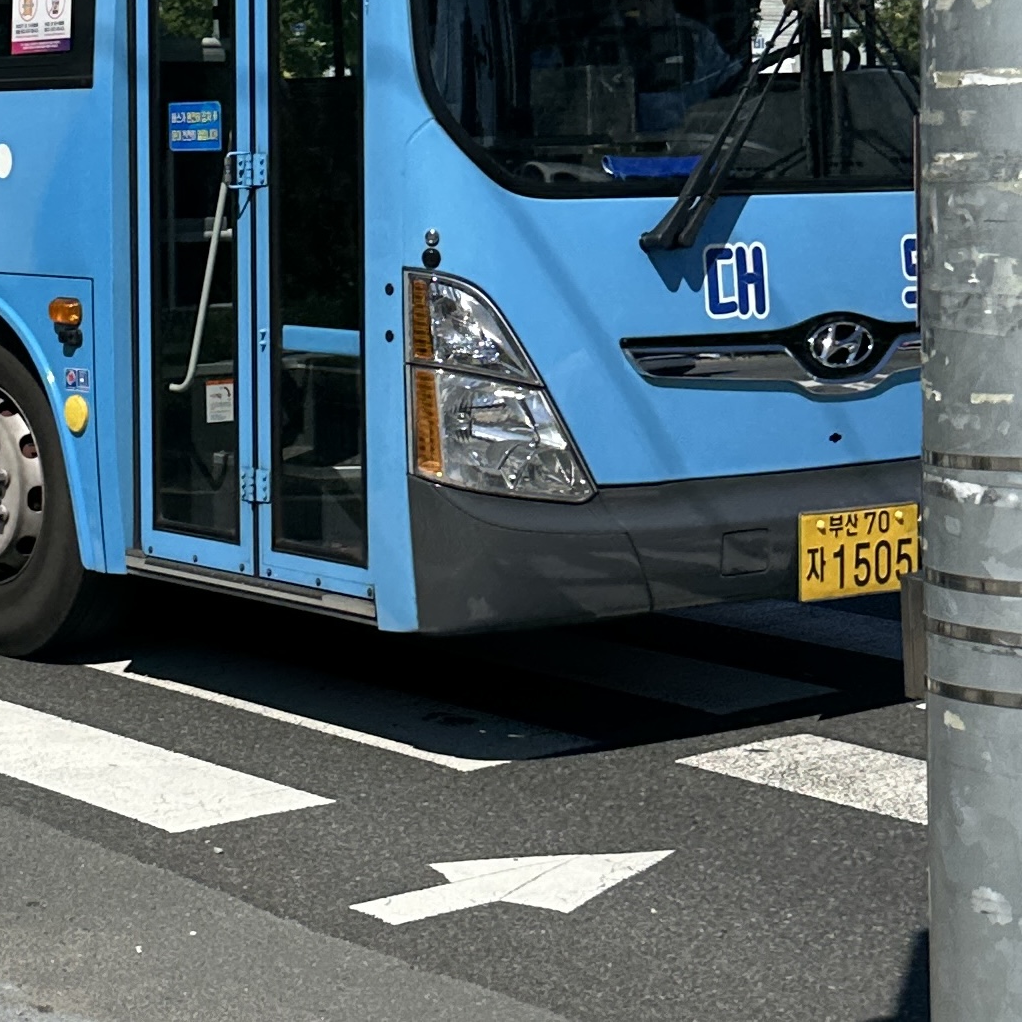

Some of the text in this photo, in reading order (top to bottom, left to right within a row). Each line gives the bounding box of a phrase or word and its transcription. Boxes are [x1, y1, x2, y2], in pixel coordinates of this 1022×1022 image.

[702, 240, 770, 320] 대
[827, 509, 891, 537] 부산 70
[805, 535, 914, 591] 자 1505
